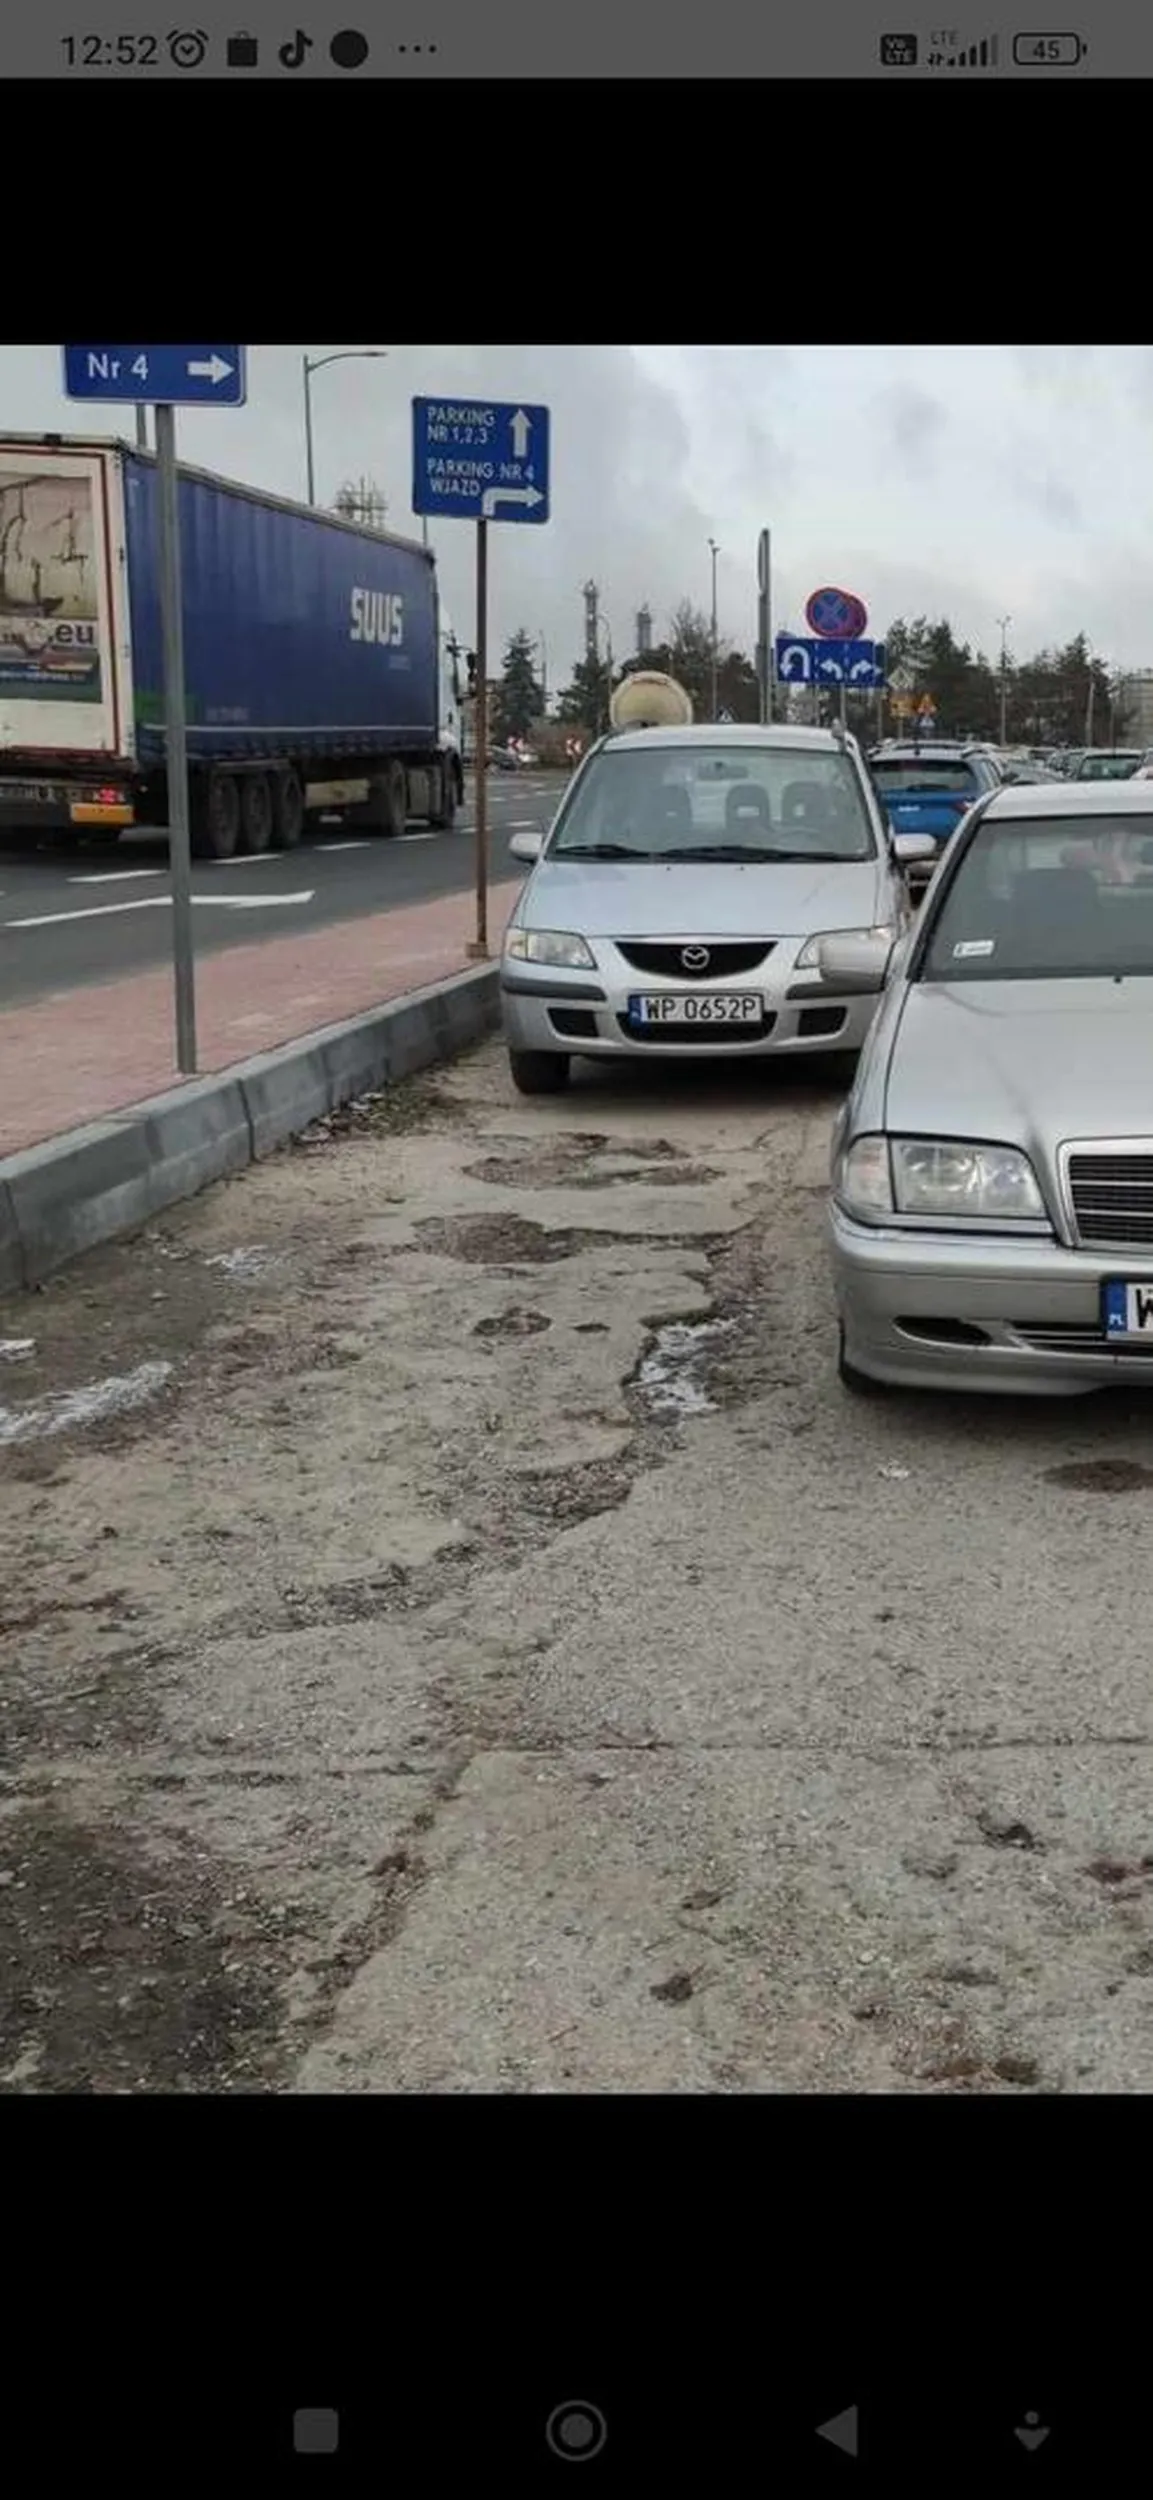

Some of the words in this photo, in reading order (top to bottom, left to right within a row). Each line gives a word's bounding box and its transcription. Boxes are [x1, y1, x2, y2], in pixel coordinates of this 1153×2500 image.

[87, 352, 121, 379] Nr
[131, 354, 149, 380] 4
[427, 406, 495, 426] PARKING
[427, 424, 448, 441] NR
[452, 426, 488, 445] 1,2,3
[427, 457, 495, 479] PARKING
[500, 462, 522, 480] NR
[524, 464, 535, 482] 4
[430, 479, 480, 497] WJAZD
[351, 586, 403, 646] SUUS
[646, 997, 676, 1019] WP
[684, 998, 756, 1019] 0652P
